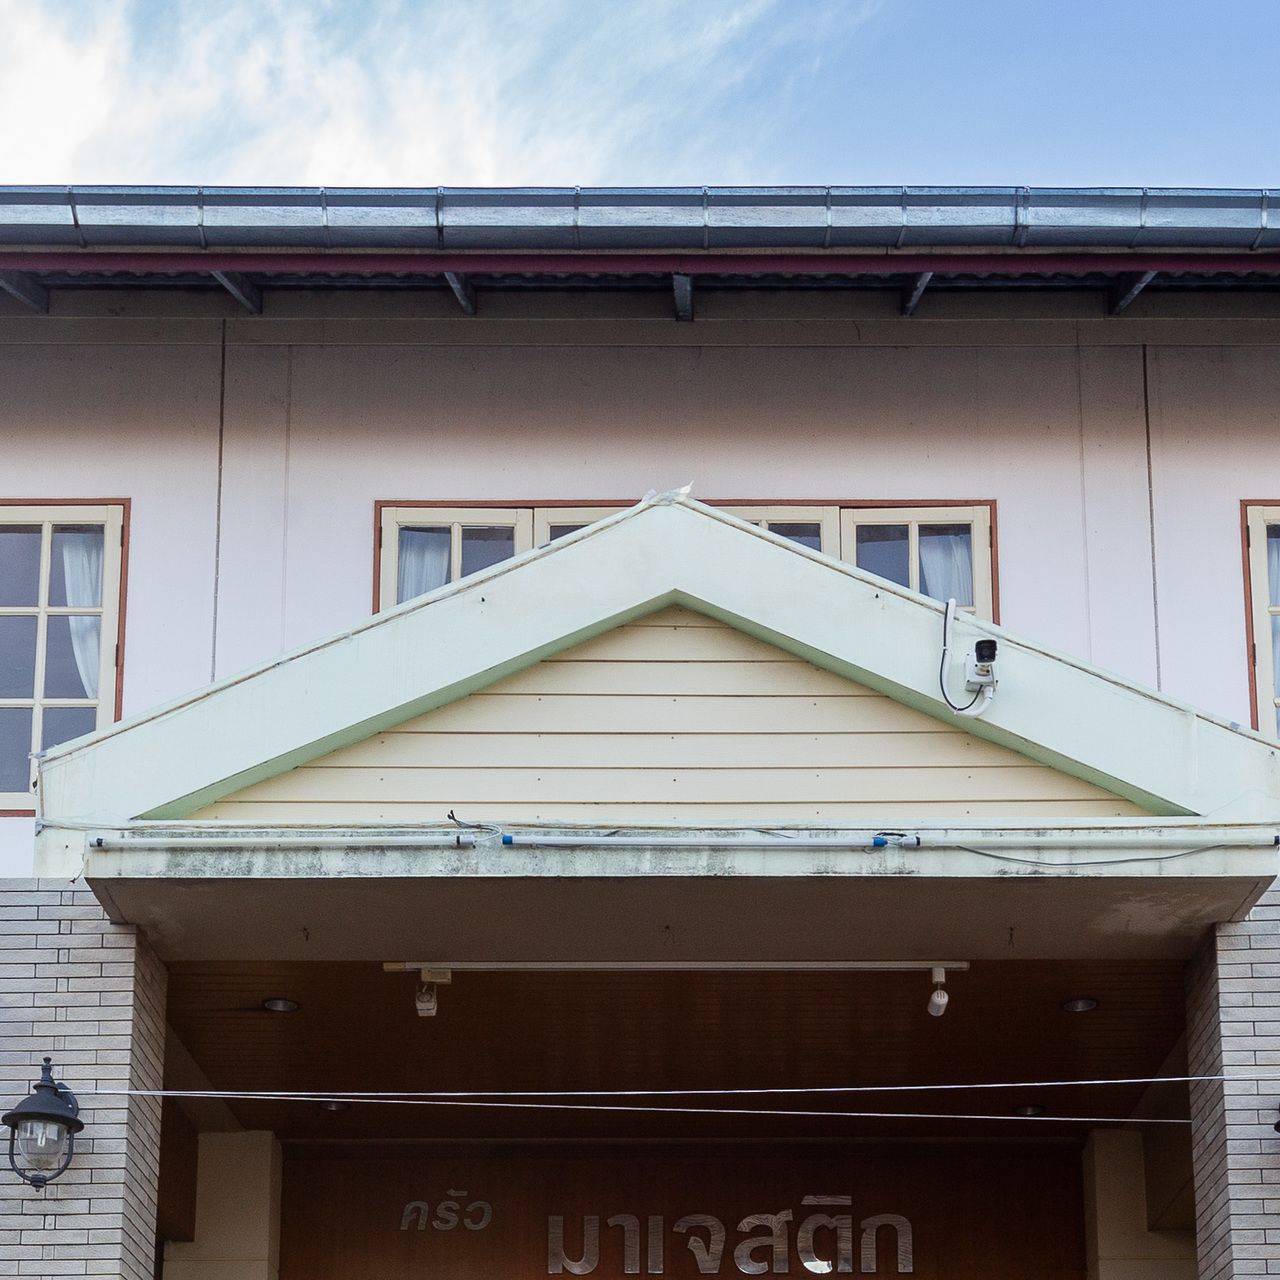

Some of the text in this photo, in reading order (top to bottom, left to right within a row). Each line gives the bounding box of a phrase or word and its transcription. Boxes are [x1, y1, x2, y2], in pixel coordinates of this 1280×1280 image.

[400, 1188, 493, 1231] ครัว
[547, 1195, 914, 1276] มาเจสติก
